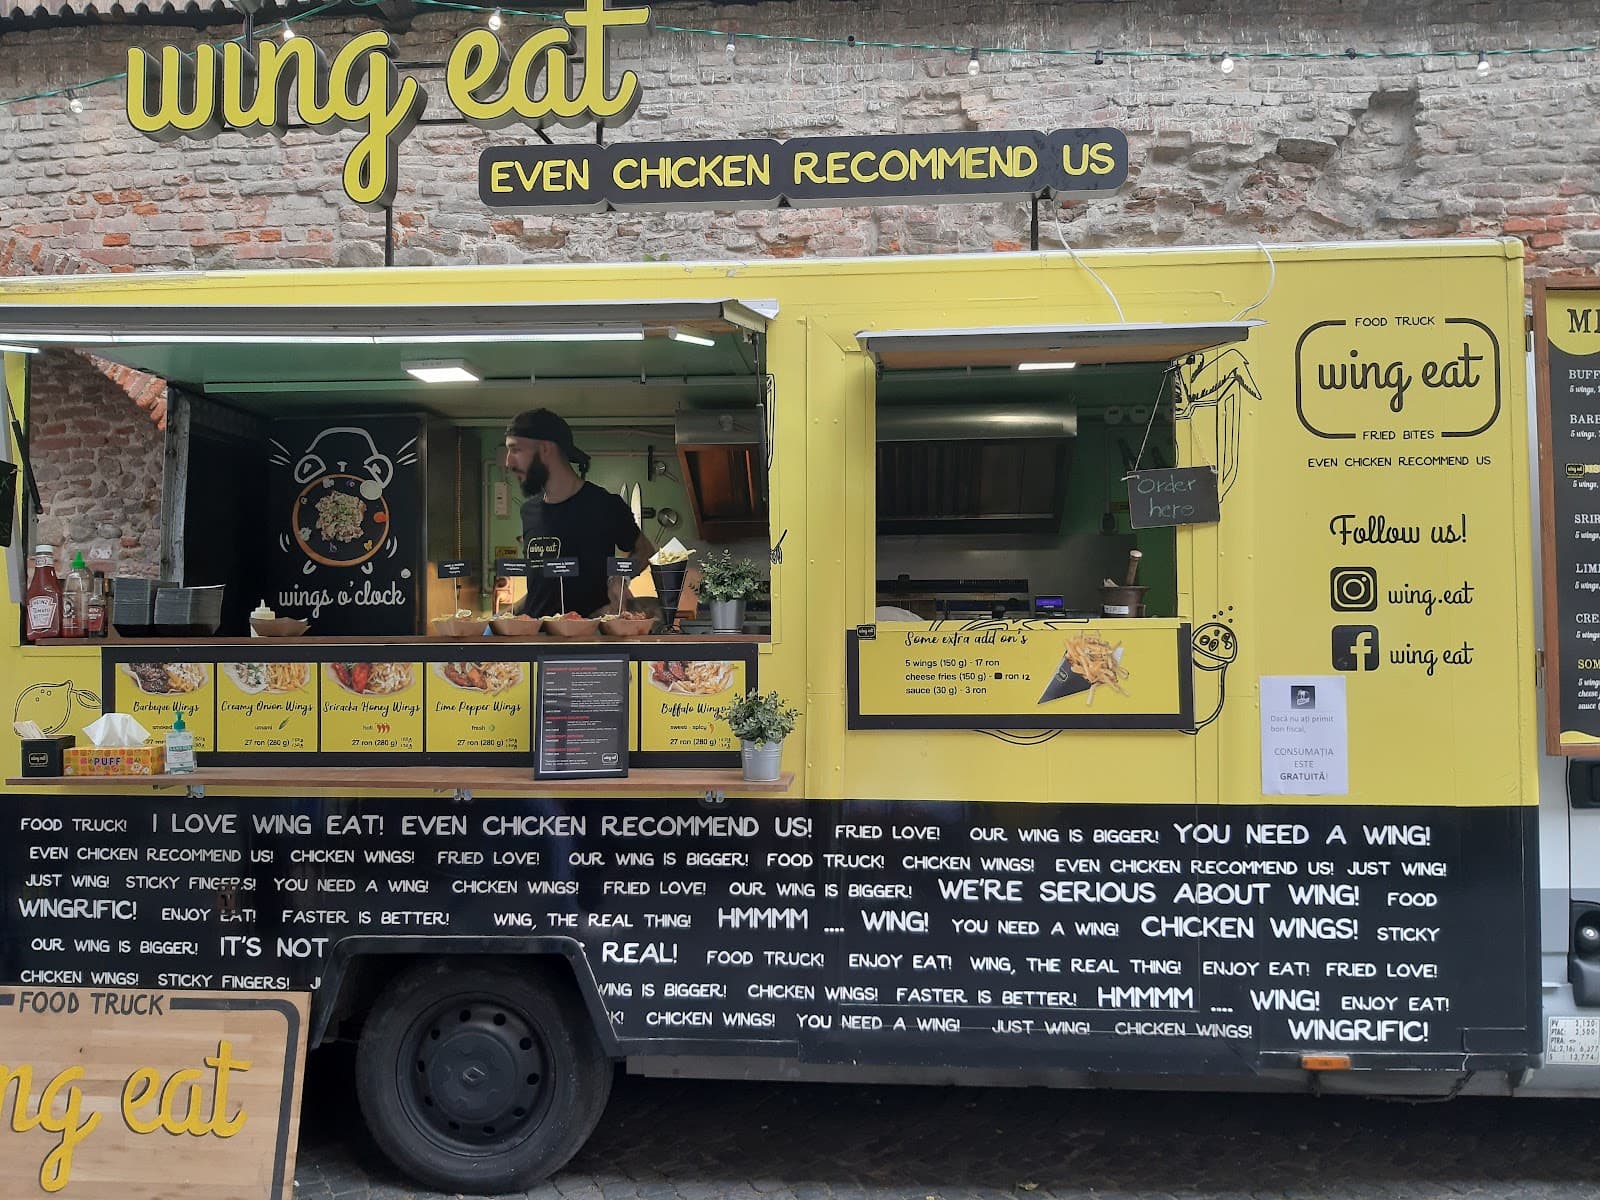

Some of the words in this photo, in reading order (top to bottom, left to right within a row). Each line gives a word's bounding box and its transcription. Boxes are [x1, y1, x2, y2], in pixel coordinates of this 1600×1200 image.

[127, 30, 419, 204] wing
[446, 0, 650, 119] eat
[490, 158, 590, 193] EVEN
[612, 153, 771, 189] CHICKEN
[794, 144, 1038, 185] RECOMMEND
[1061, 143, 1115, 177] US
[1355, 317, 1388, 326] FOOD
[1395, 316, 1435, 326] TRUCK
[1318, 349, 1412, 412] wing
[1422, 343, 1483, 388] eat
[1363, 431, 1396, 440] FRIED
[1403, 430, 1435, 439] BITES
[1308, 458, 1338, 468] EVEN
[1345, 457, 1391, 467] CHICKEN
[1399, 456, 1469, 466] RECOMMEND
[1476, 456, 1491, 465] US
[1137, 474, 1196, 494] Order
[1149, 497, 1194, 519] here
[1329, 514, 1420, 546] Follow
[1431, 513, 1467, 544] us!
[530, 544, 544, 557] wing
[546, 542, 558, 552] eat
[1576, 564, 1600, 573] LIM
[278, 586, 333, 619] wings
[1388, 581, 1474, 616] wing.eat
[1576, 614, 1600, 623] CRE
[905, 631, 939, 646] Some
[943, 633, 969, 645] extra
[975, 631, 995, 644] add
[1001, 631, 1028, 644] on's
[913, 660, 937, 669] wings
[940, 659, 957, 667] (150
[959, 659, 967, 668] g)
[1390, 644, 1438, 676] wing
[1443, 641, 1474, 665] eat
[960, 673, 975, 681] (150
[978, 673, 986, 681] g)
[933, 686, 946, 695] (30
[949, 687, 957, 695] g)
[966, 686, 970, 694] 3
[133, 701, 170, 714] Barbeque
[172, 701, 199, 716] Wings
[222, 701, 253, 715] Creamy
[257, 701, 282, 711] Onion
[286, 701, 312, 716] Wings
[362, 701, 389, 717] Honey
[392, 701, 420, 716] Wings
[435, 702, 456, 712] Lime
[459, 702, 490, 715] Pepper
[493, 702, 521, 716] Wings
[661, 703, 694, 717] Buffalo
[1311, 715, 1334, 724] primit
[94, 757, 121, 765] PUFF
[1294, 760, 1314, 768] ESTE
[20, 817, 63, 832] FOOD
[71, 818, 128, 833] TRUCK!
[152, 813, 158, 833] I
[171, 812, 238, 834] LOVE
[251, 813, 312, 835] WING
[326, 814, 384, 836] EAT!
[401, 814, 467, 836] EVEN
[482, 815, 587, 837] CHICKEN
[601, 815, 760, 837] RECOMMEND
[774, 816, 813, 839] US!
[834, 824, 883, 840] FRIED
[891, 825, 941, 841] LOVE!
[969, 826, 1009, 842] OUR
[1017, 827, 1060, 843] WING
[1068, 828, 1084, 843] IS
[1092, 828, 1160, 845] BIGGER!
[1172, 822, 1231, 845] YOU
[1245, 823, 1310, 845] NEED
[1325, 824, 1348, 845] A
[1362, 824, 1431, 847] WING!
[17, 897, 137, 921] WINGRIFIC!
[161, 907, 212, 922] ENJOY
[281, 909, 350, 924] FASTER
[358, 910, 372, 925] IS
[380, 910, 450, 926] BETTER!
[717, 906, 809, 931] HMMMM
[860, 909, 929, 934] WING!
[1140, 915, 1255, 939] CHICKEN
[1269, 916, 1359, 941] WINGS!
[19, 991, 79, 1014] FOOD
[90, 992, 165, 1016] TRUCK
[1249, 988, 1321, 1012] WING!
[1340, 995, 1399, 1011] ENJOY
[1408, 996, 1450, 1013] EAT!
[1287, 1018, 1429, 1043] WINGRIFIC!
[0, 1065, 102, 1192] ng
[121, 1039, 253, 1138] eat
